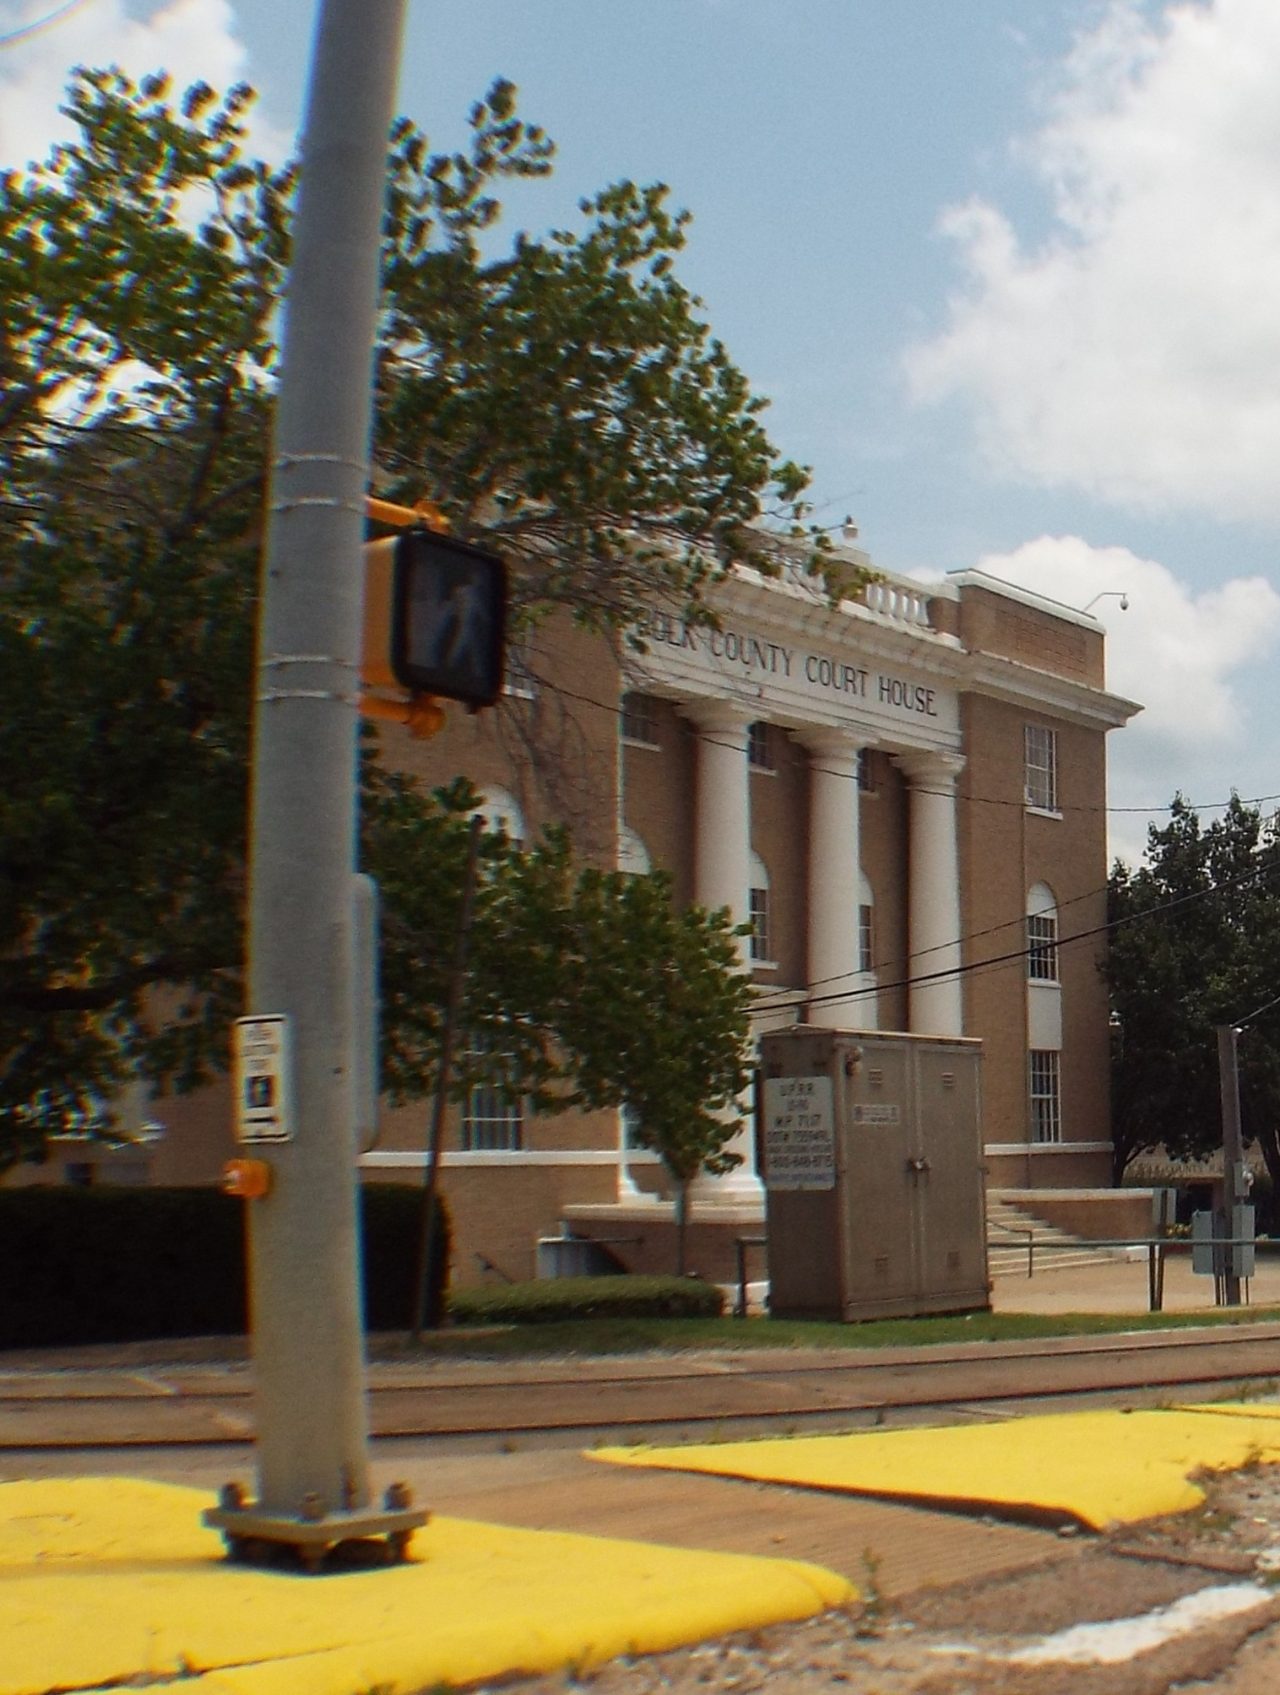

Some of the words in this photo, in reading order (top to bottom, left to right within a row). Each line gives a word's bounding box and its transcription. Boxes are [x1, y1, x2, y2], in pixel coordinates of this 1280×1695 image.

[710, 629, 791, 677] COUNTY
[806, 655, 869, 697] COURT
[878, 675, 938, 717] HOUSE
